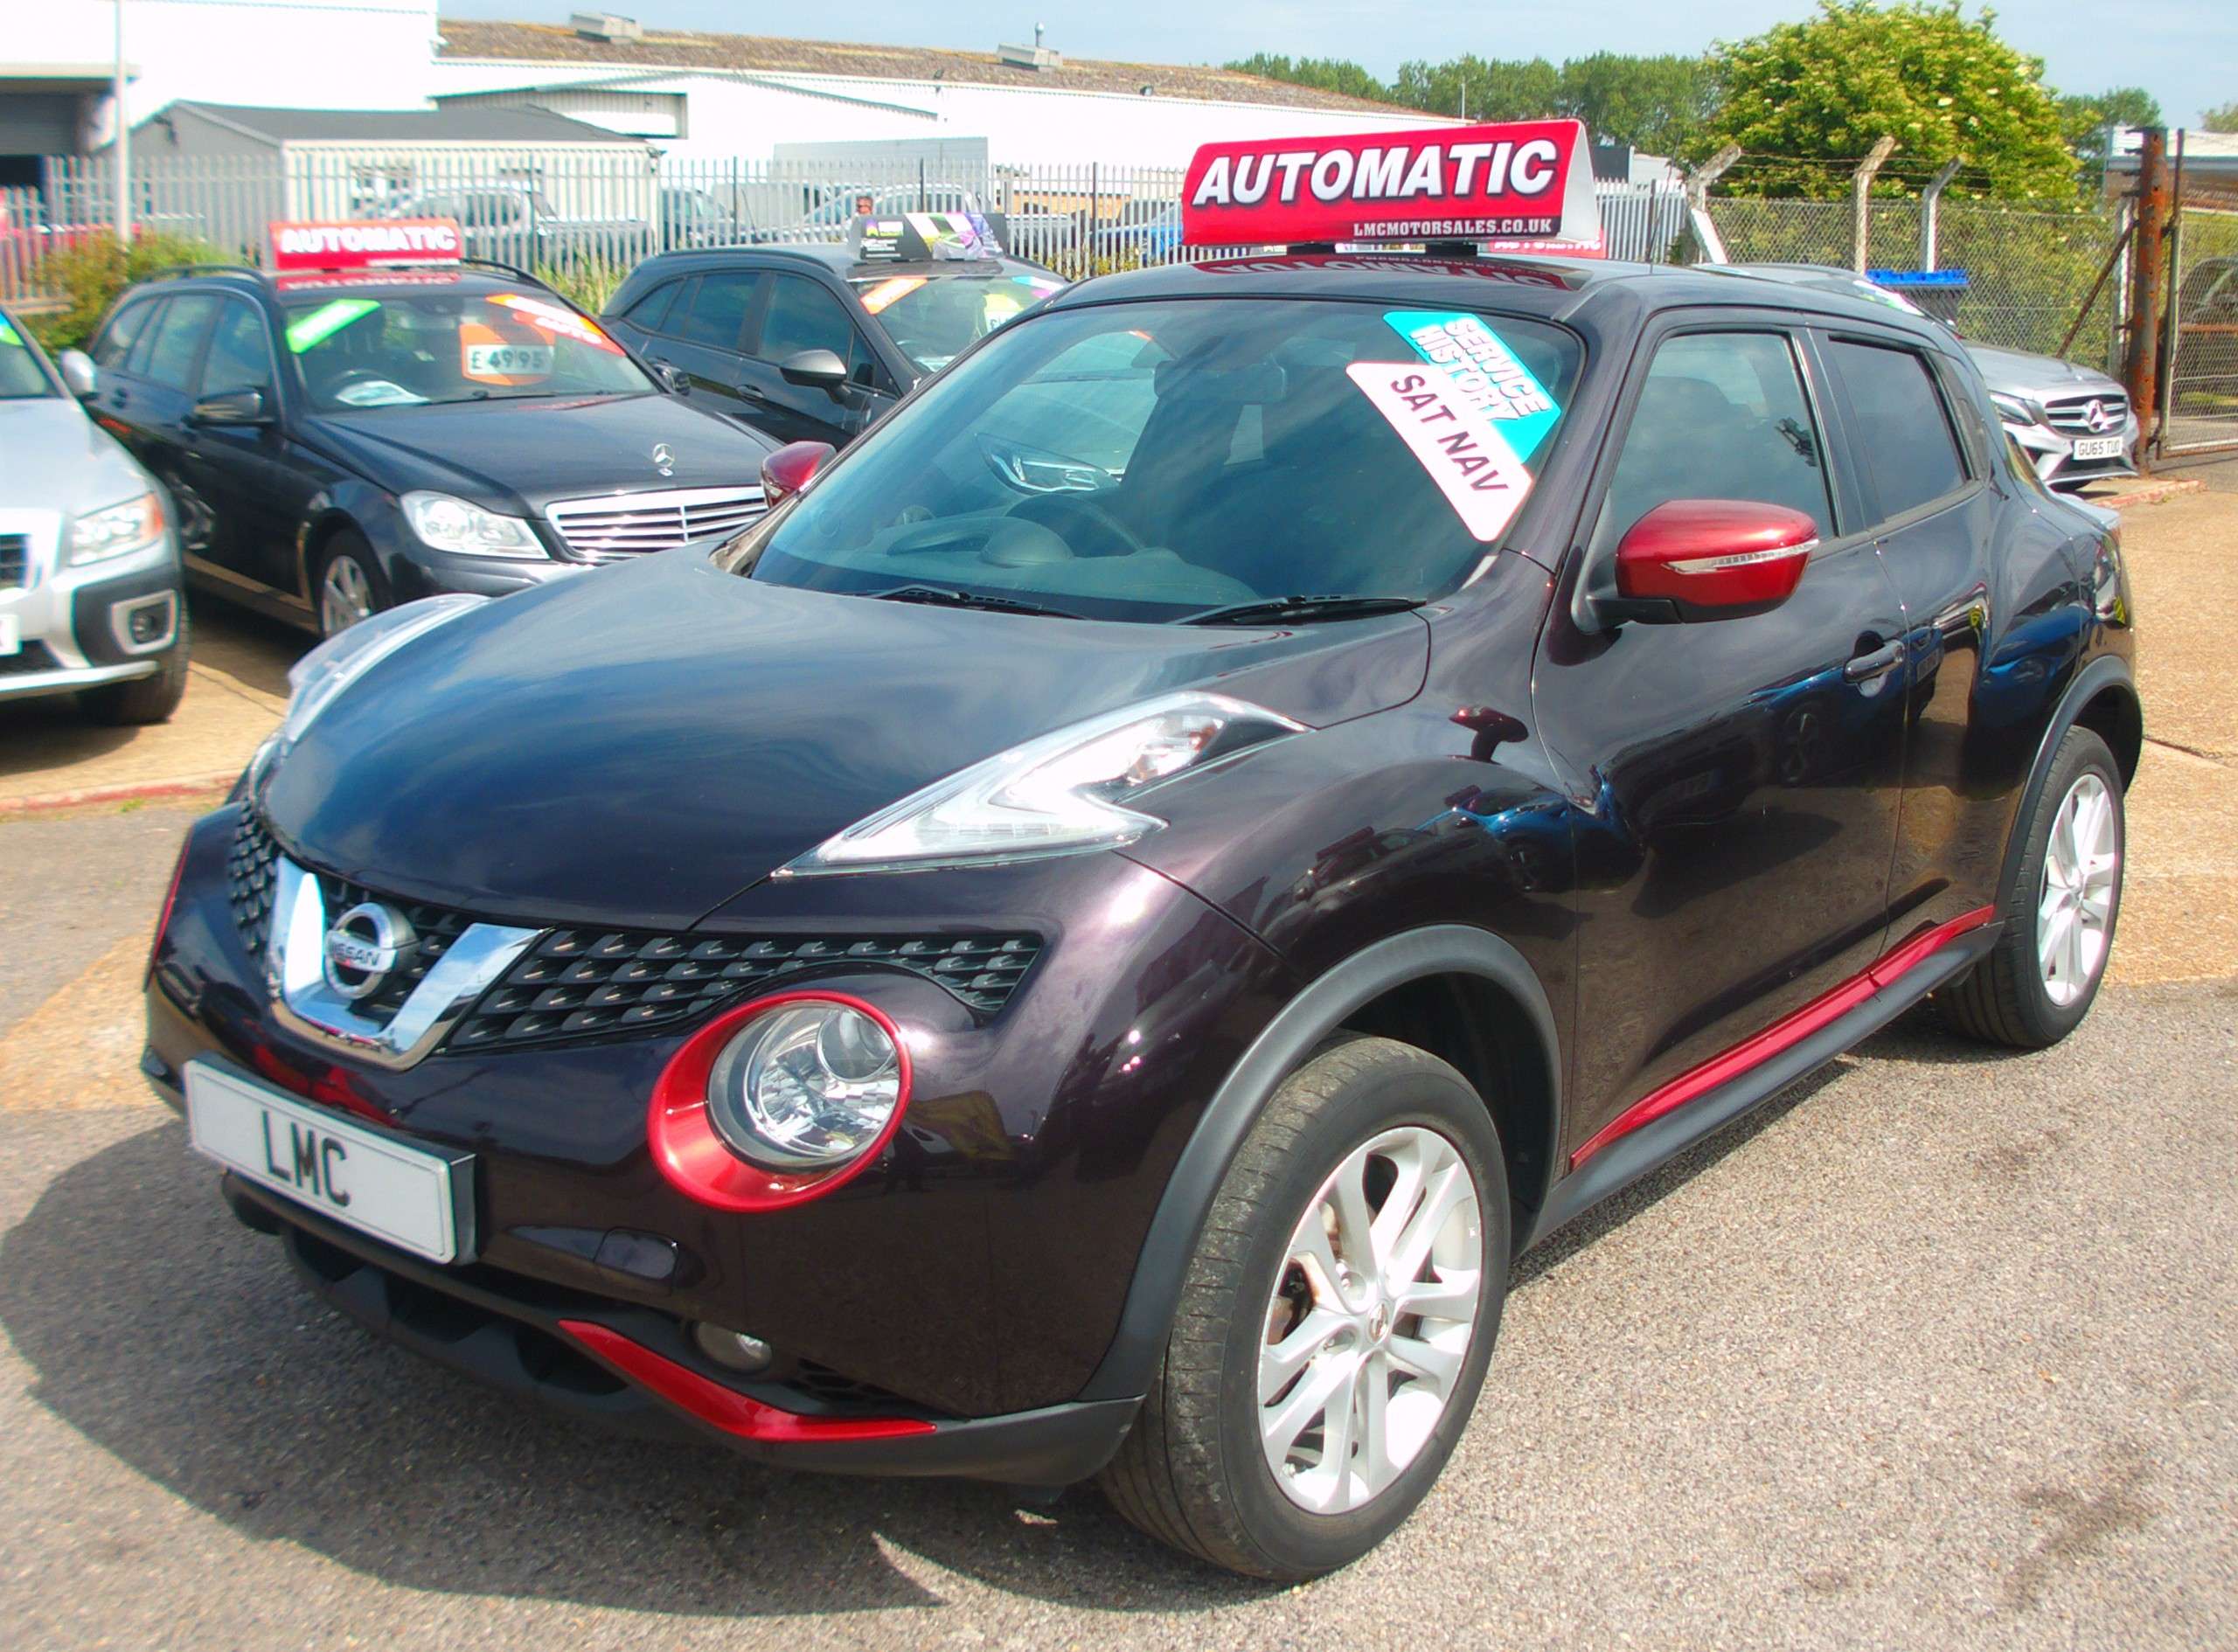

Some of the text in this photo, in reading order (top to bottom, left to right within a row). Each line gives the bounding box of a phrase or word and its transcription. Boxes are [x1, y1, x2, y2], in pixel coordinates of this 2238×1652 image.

[1192, 138, 1558, 206] AUTOMATIC
[280, 226, 457, 254] AUTOMATIC
[1352, 219, 1553, 238] LMCMOTORSALES.CO.UK
[1443, 317, 1553, 418] SERVICE
[1390, 374, 1509, 490] SAT NAV
[261, 1110, 350, 1207] LMC
